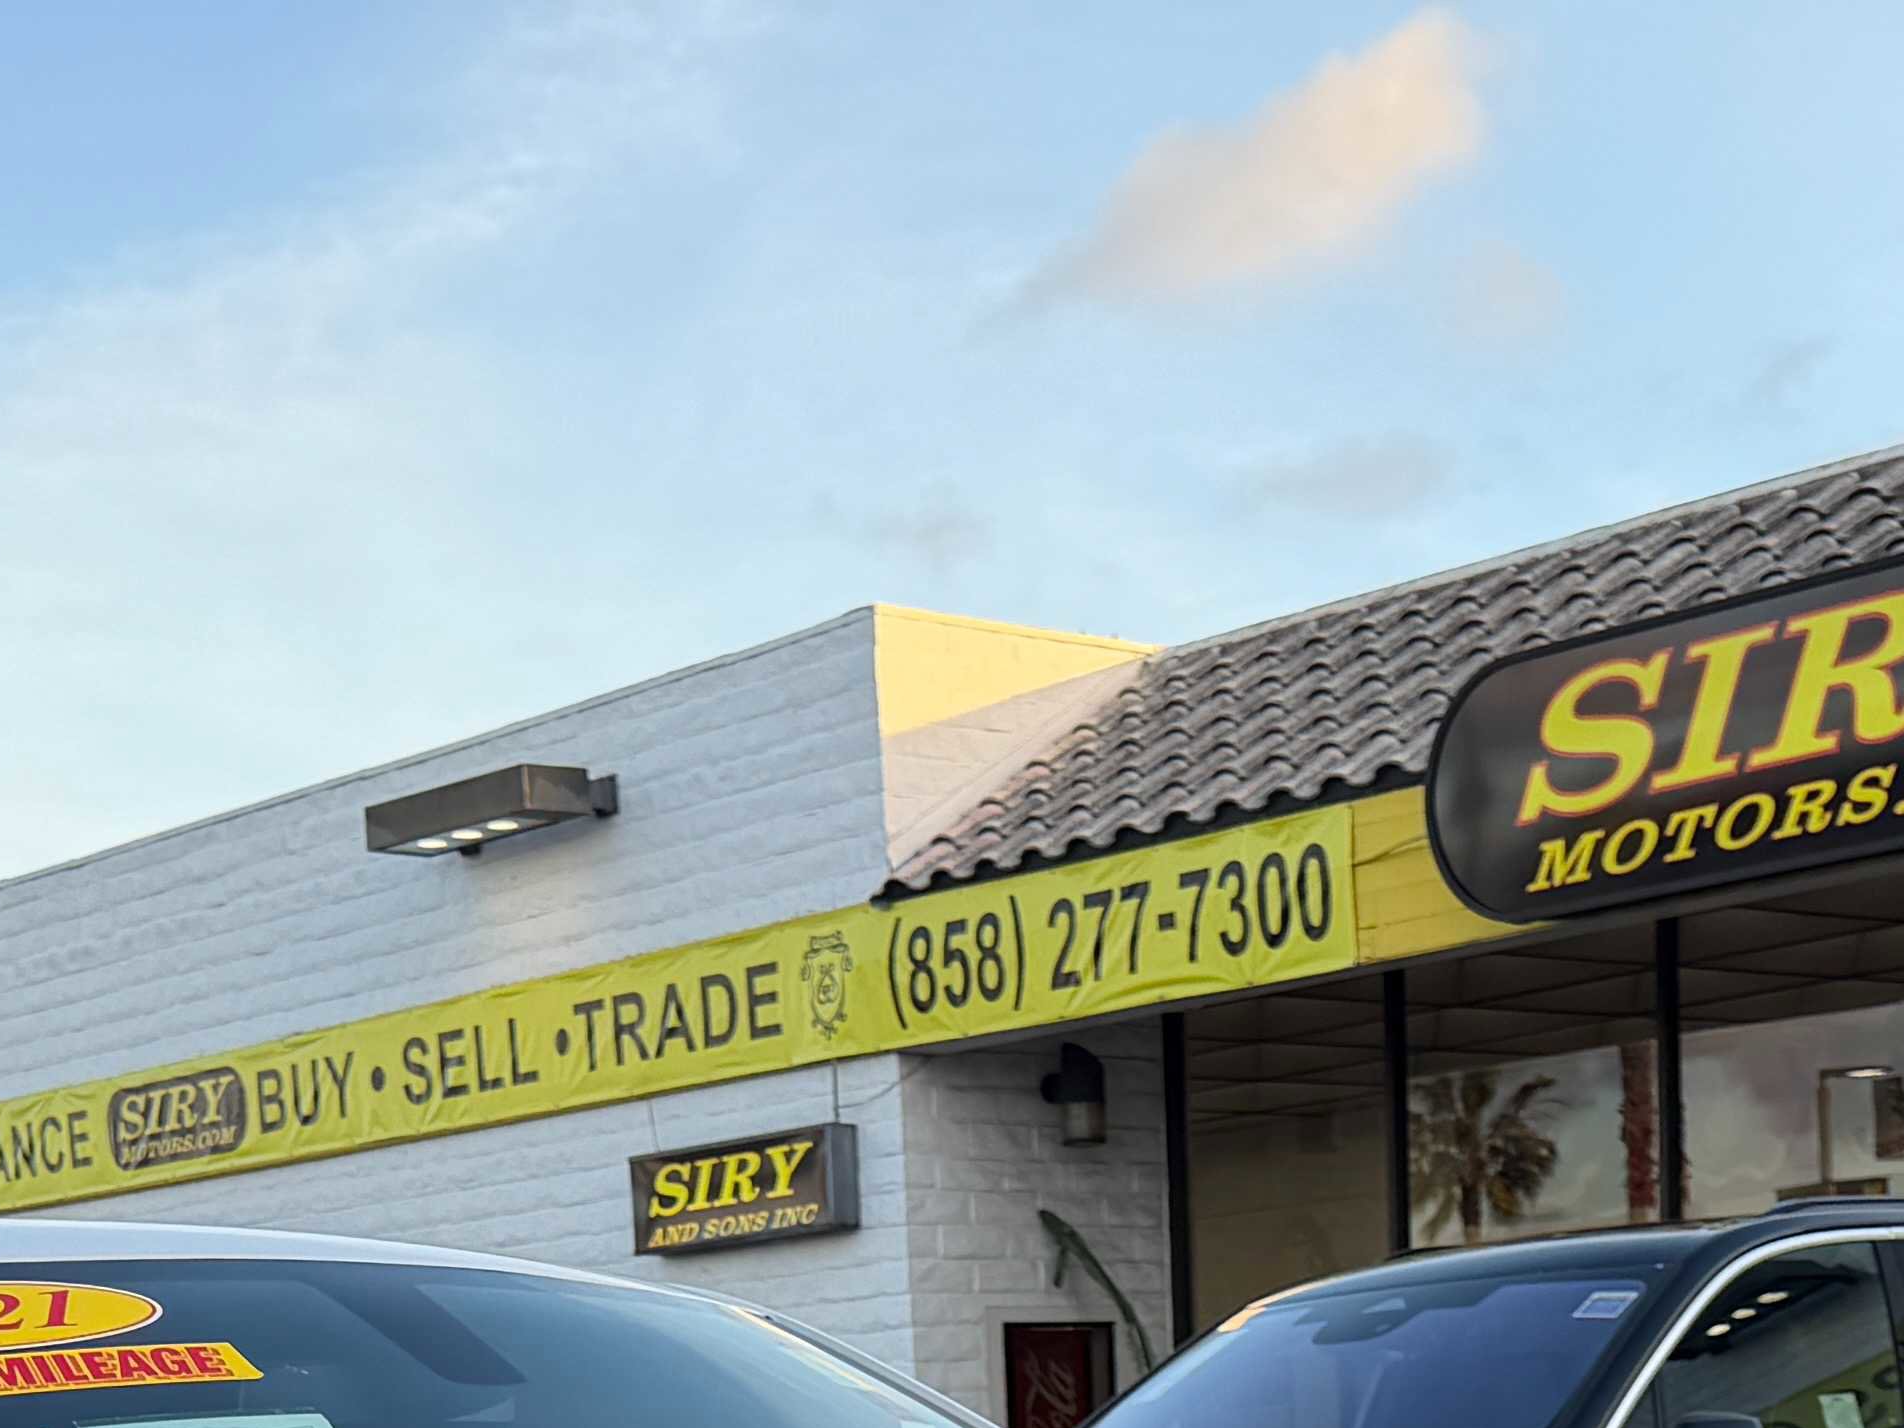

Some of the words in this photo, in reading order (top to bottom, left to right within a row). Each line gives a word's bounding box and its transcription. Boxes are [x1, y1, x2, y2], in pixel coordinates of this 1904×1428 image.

[887, 894, 1026, 1031] (858)
[1047, 842, 1332, 990] 277-7300
[257, 1051, 354, 1134] BUY
[402, 1018, 539, 1105] SELL
[573, 962, 783, 1071] TRADE
[117, 1074, 235, 1143] SIRY
[649, 1141, 814, 1218] SIRY
[648, 1222, 699, 1249] AND
[703, 1211, 770, 1240] SONS
[772, 1204, 819, 1230] INC
